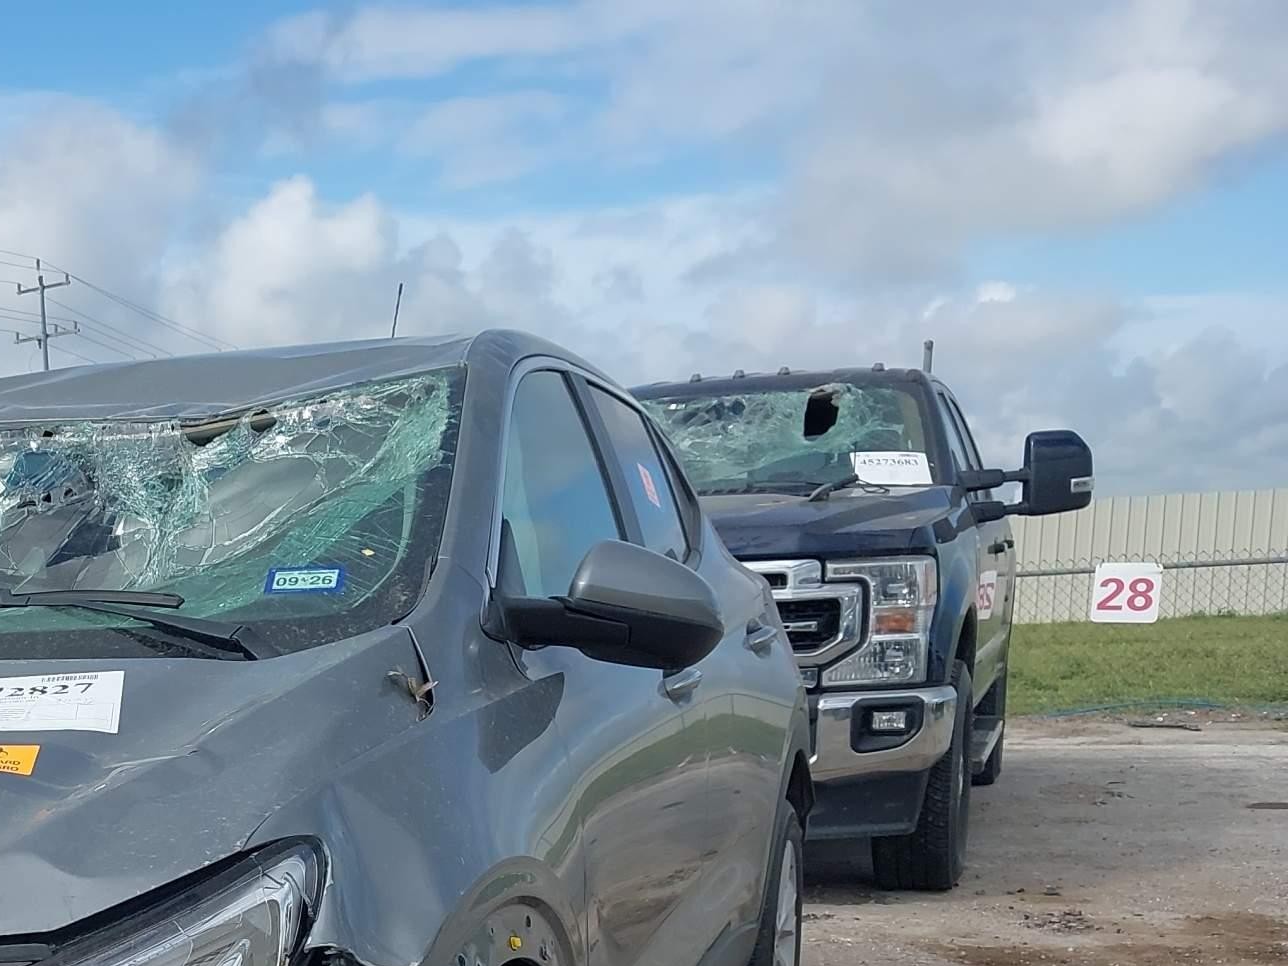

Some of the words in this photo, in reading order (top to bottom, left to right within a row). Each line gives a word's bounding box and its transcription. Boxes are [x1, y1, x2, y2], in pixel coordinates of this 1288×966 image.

[276, 576, 299, 587] 09
[309, 575, 333, 585] 26
[1096, 577, 1155, 611] 28
